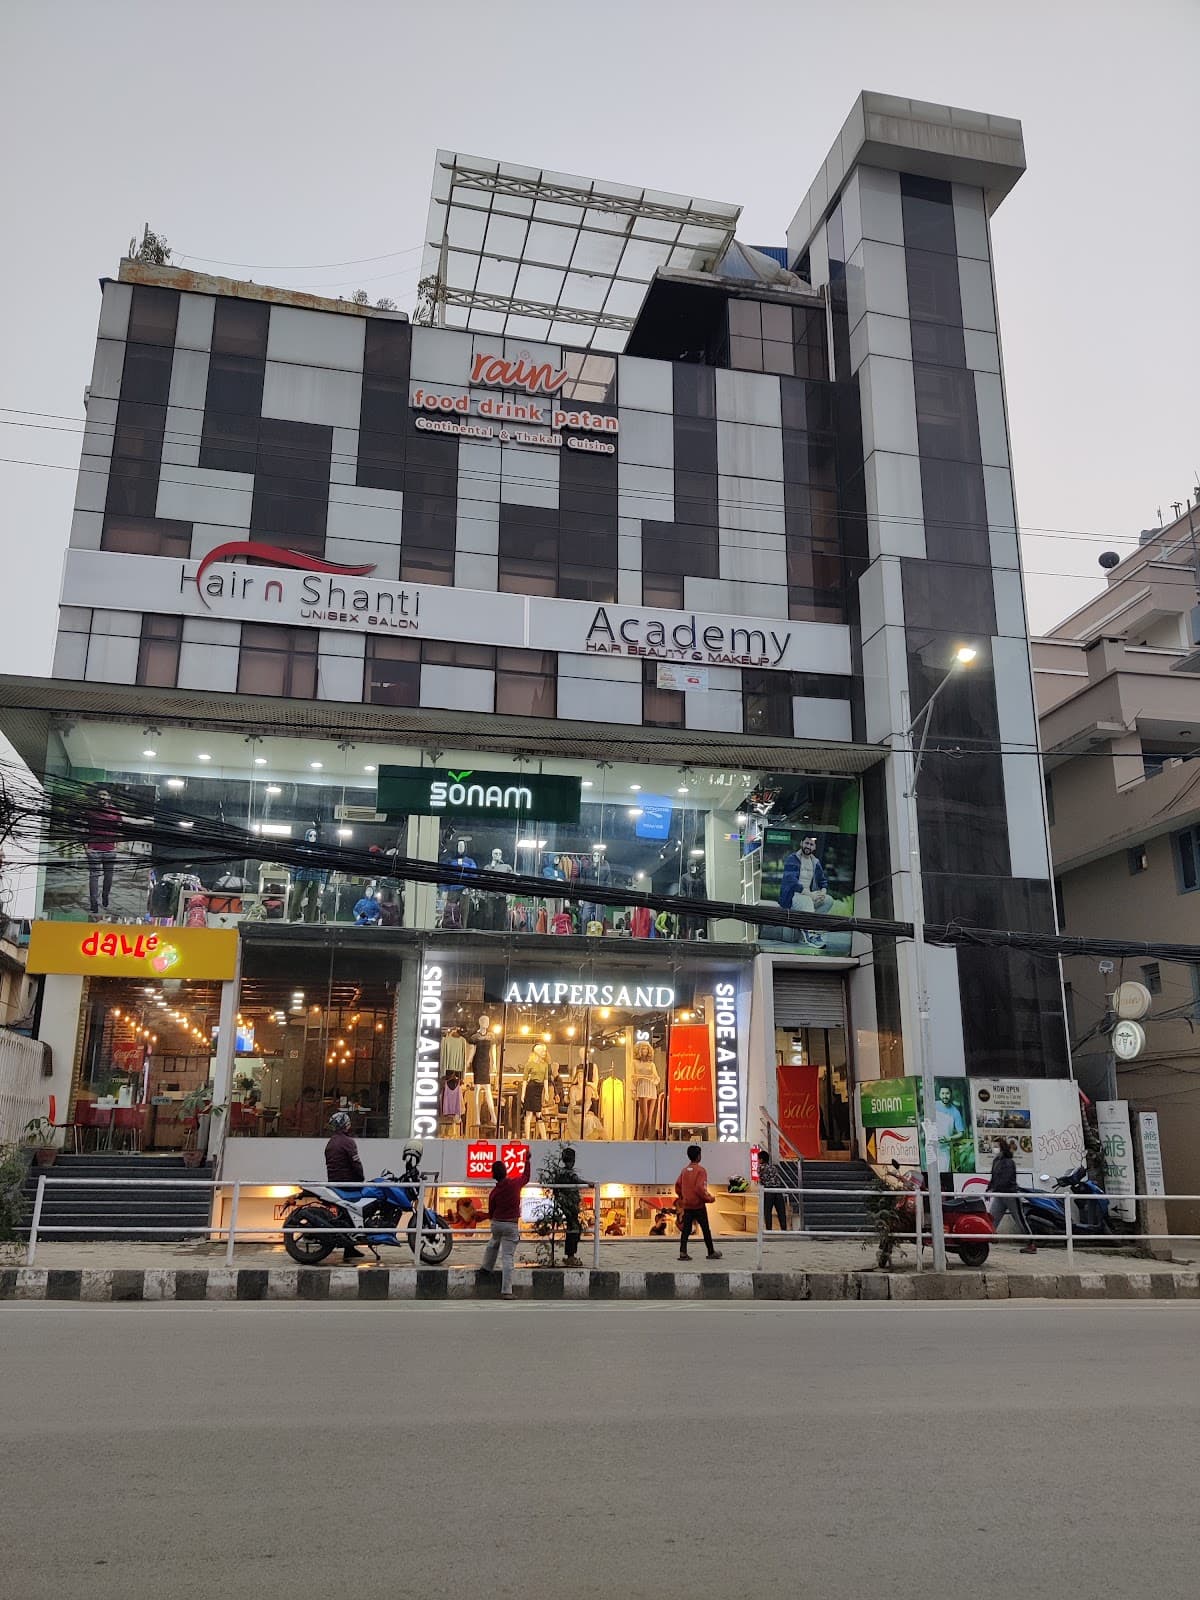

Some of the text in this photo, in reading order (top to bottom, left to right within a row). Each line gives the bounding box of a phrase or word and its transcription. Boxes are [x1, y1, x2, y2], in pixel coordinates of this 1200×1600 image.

[470, 353, 568, 391] rain
[415, 390, 618, 431] food drink patan
[417, 419, 615, 453] Continental & Thakali Cuisine
[265, 580, 283, 602] n
[300, 575, 420, 616] Shanti
[300, 610, 419, 630] UNISEX SALON
[586, 606, 791, 666] Academy
[586, 641, 770, 666] HAIR BEAUTY & MAKEUP
[504, 981, 675, 1008] AMPERSAND
[673, 1053, 706, 1081] sale
[783, 1094, 817, 1119] sale
[470, 1151, 493, 1161] MINI
[504, 1148, 526, 1161] メイ
